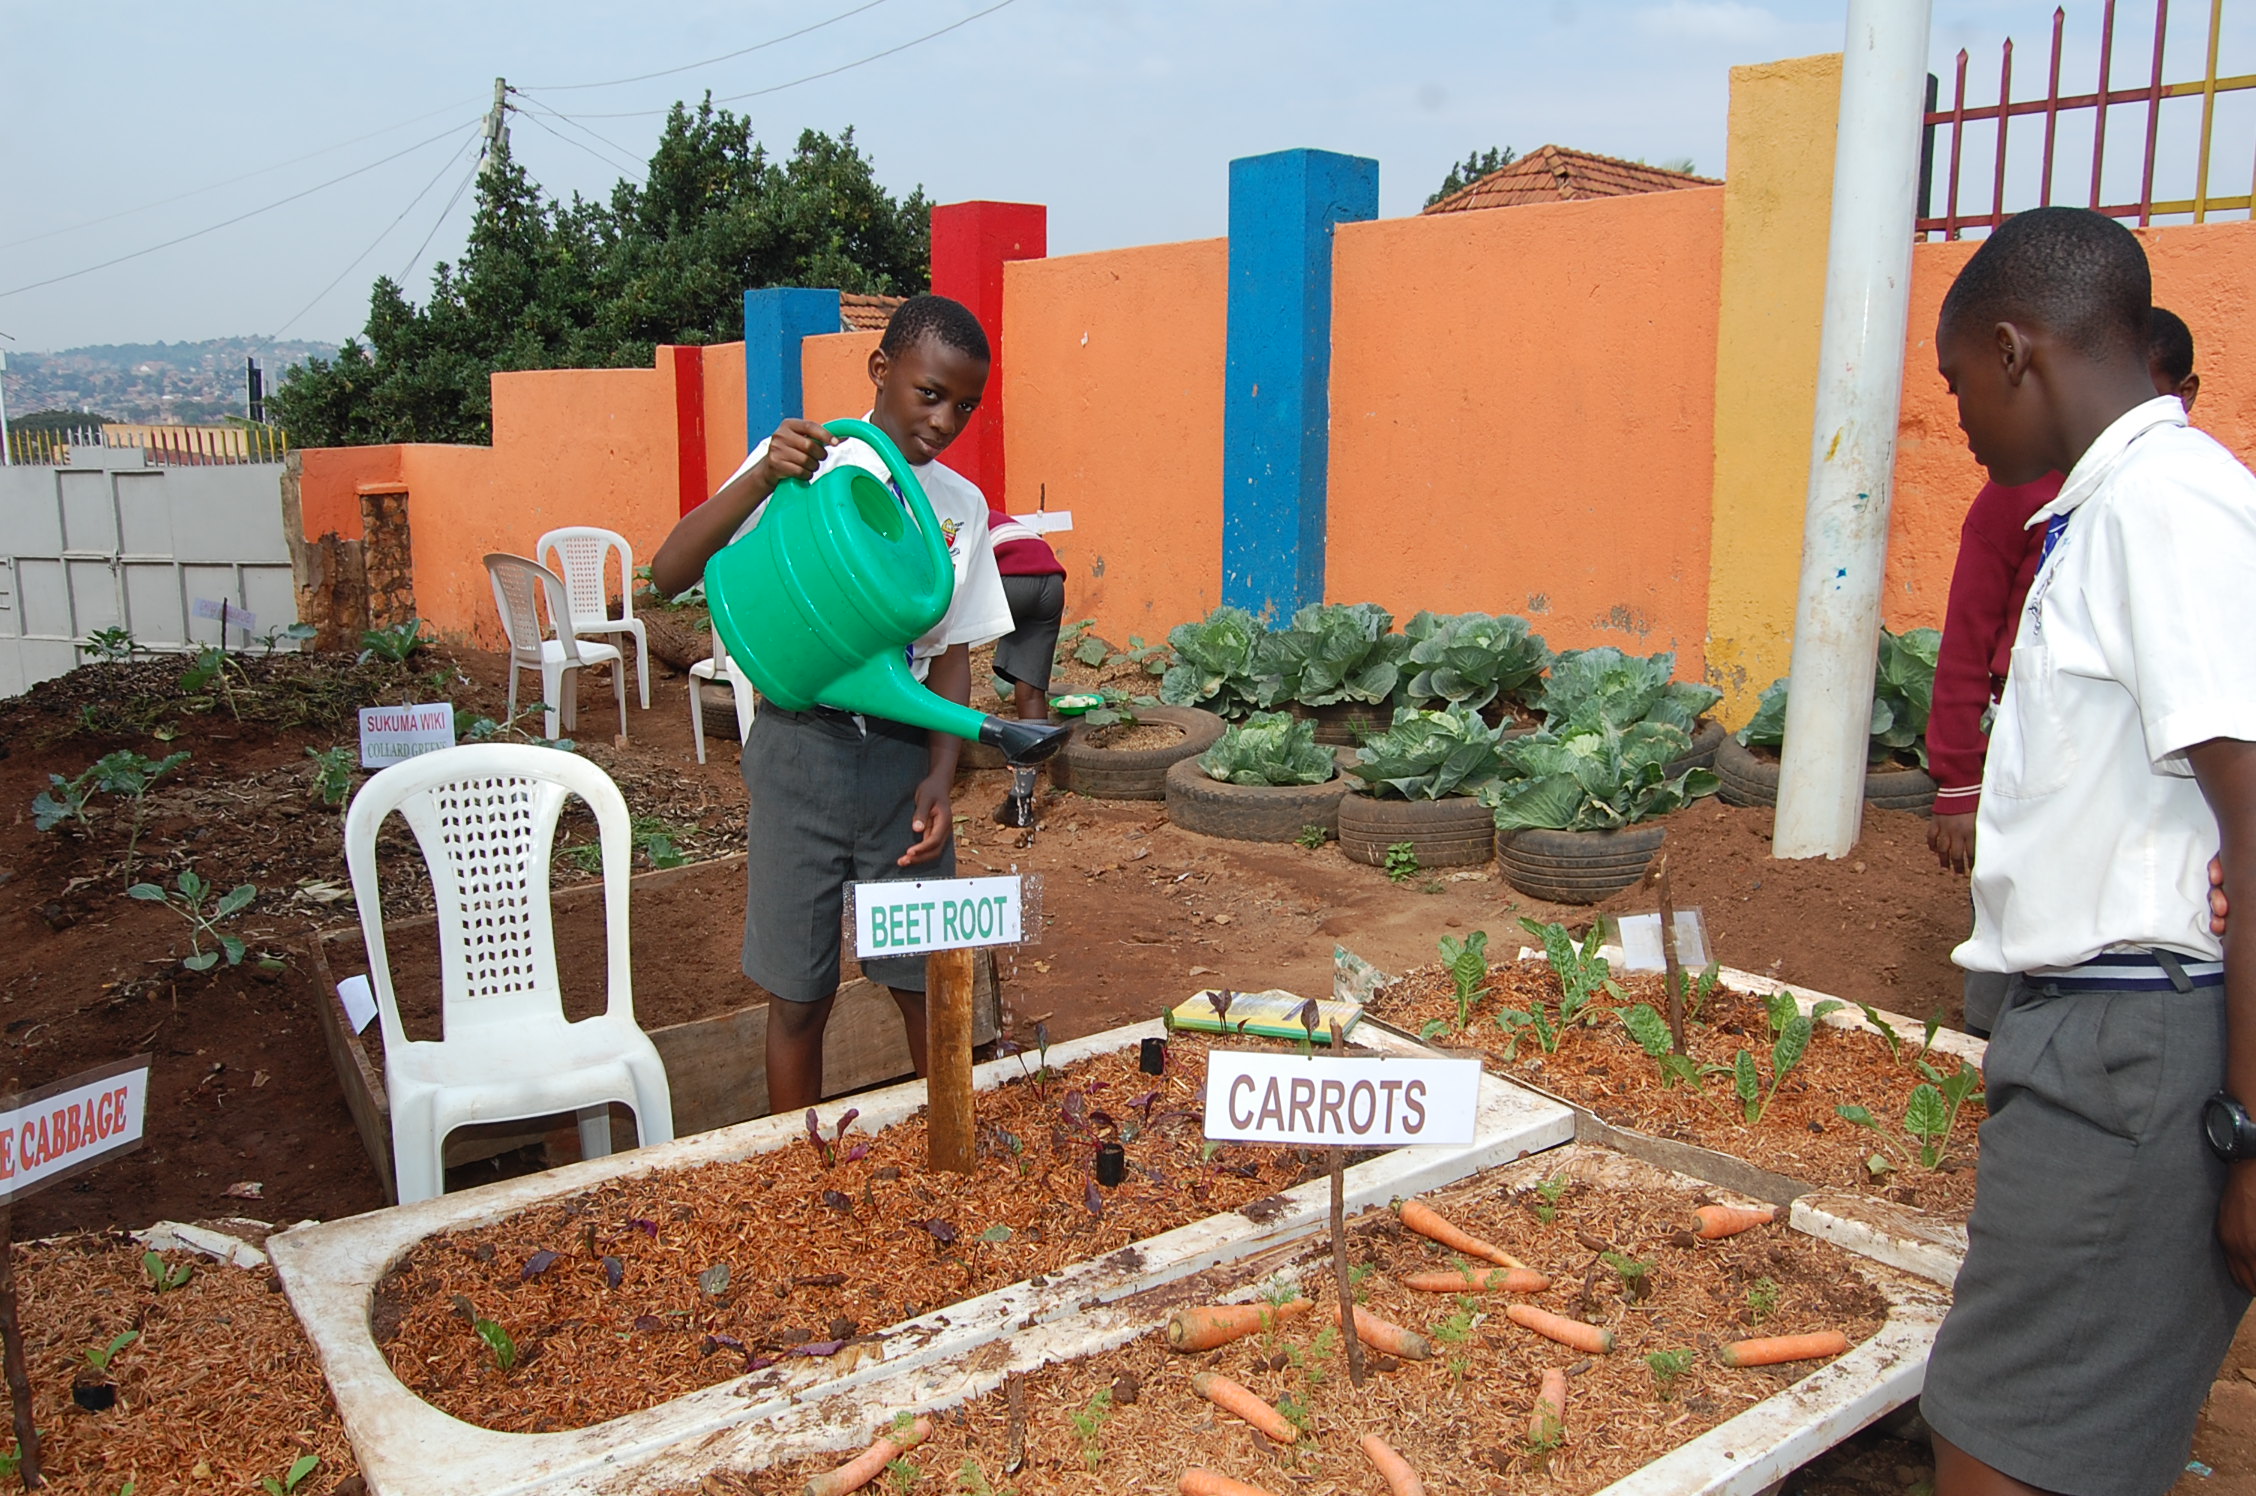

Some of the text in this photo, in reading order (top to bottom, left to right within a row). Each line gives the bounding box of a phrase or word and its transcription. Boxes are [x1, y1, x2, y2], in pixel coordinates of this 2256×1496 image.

[367, 712, 446, 732] SUKUMA WIKI
[367, 743, 410, 758] COLLARD
[871, 896, 1007, 948] BEET ROOT
[20, 1086, 128, 1171] CABBAGE
[1228, 1074, 1427, 1135] CARROTS
